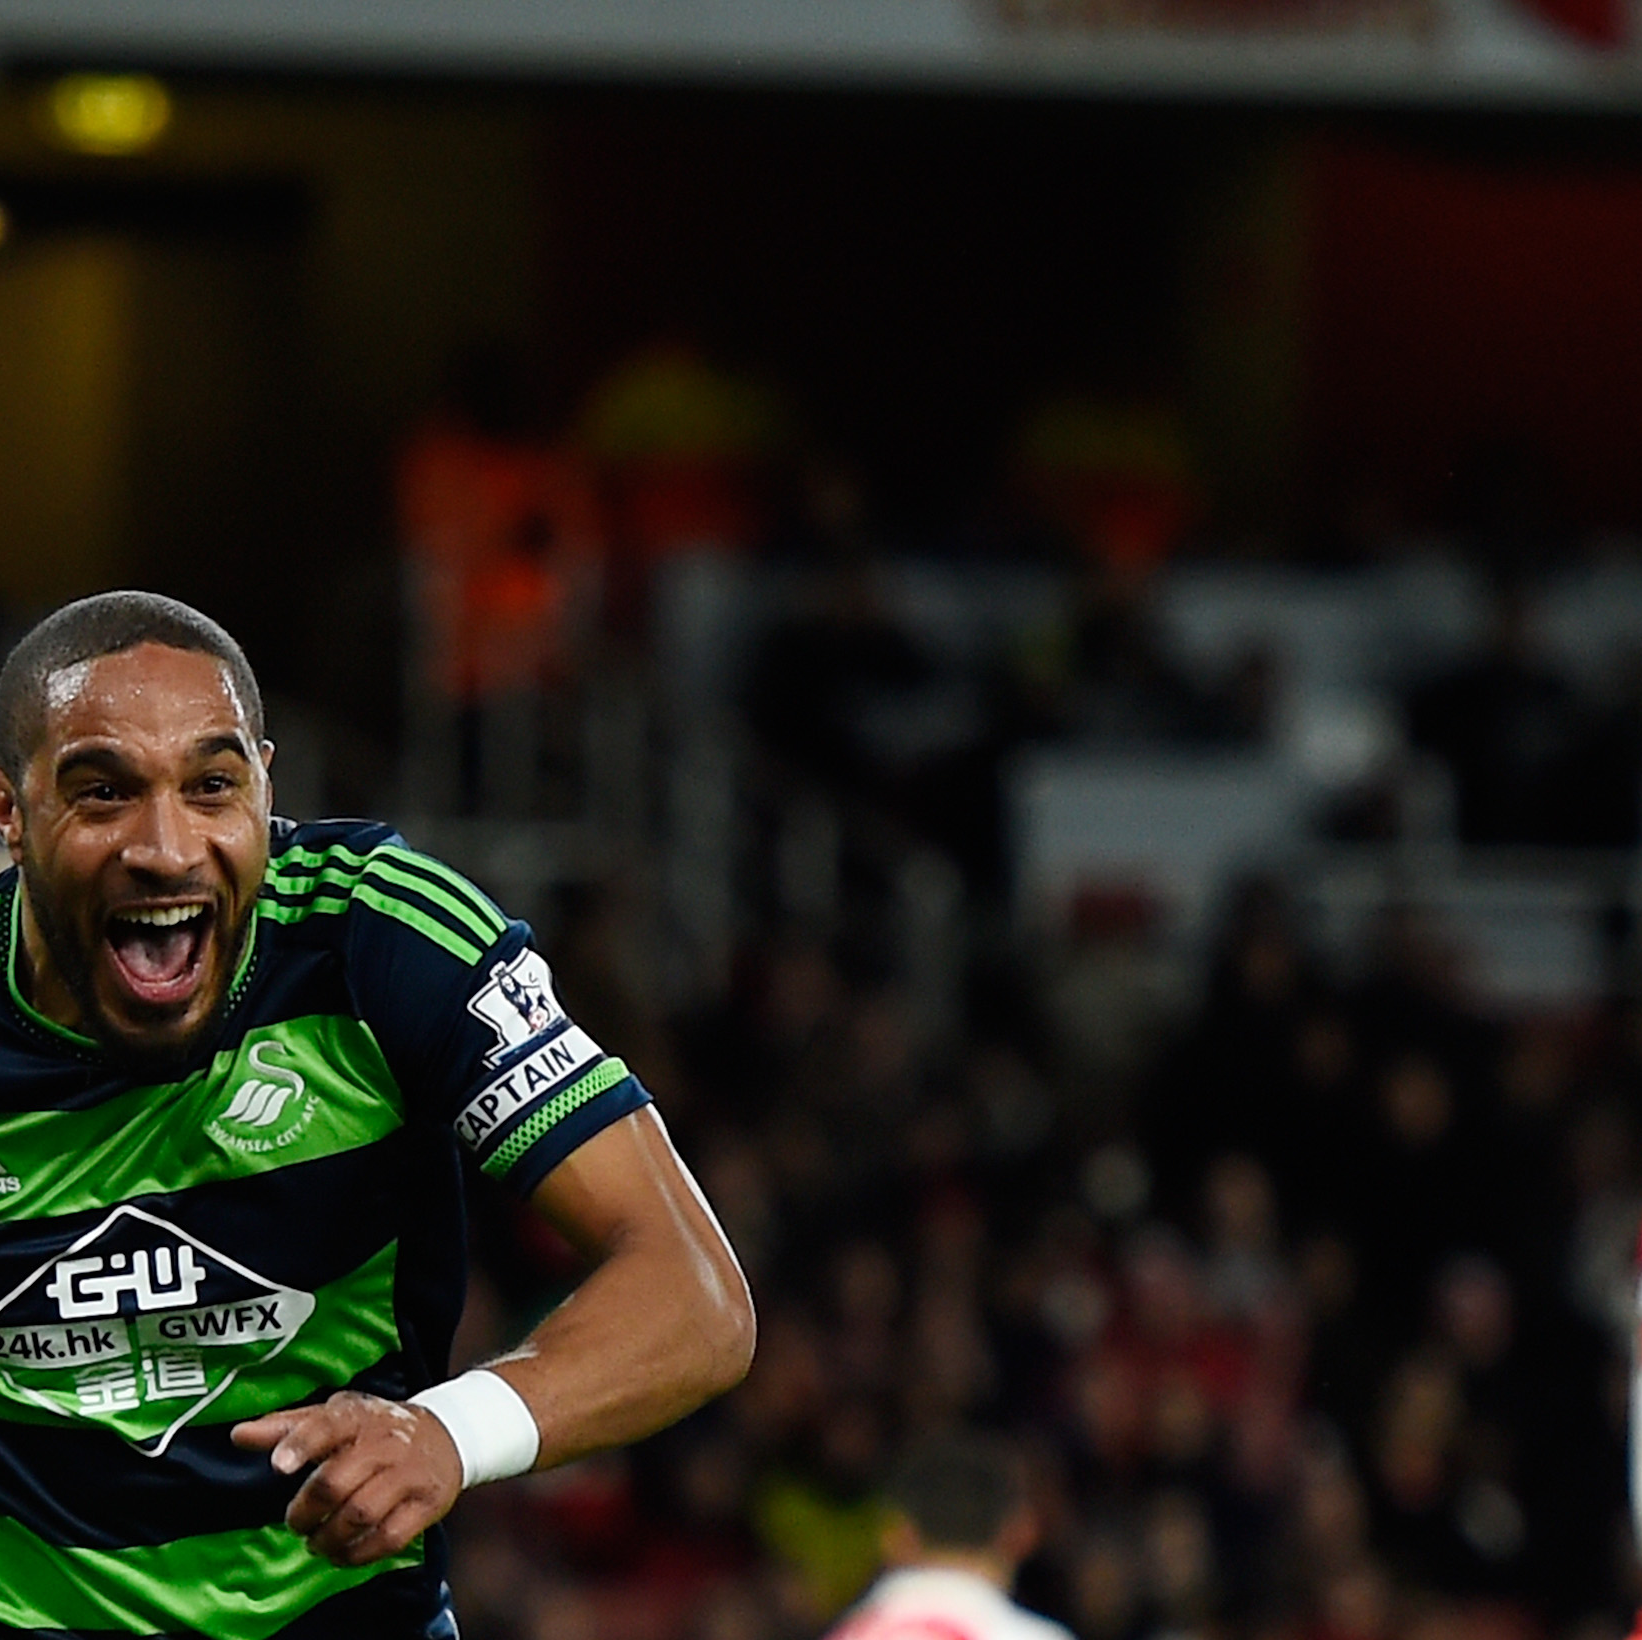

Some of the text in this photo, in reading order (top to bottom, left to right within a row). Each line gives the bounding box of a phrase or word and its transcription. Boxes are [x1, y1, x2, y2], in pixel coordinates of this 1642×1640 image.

[458, 1040, 576, 1146] CAPTAIN
[207, 1120, 274, 1152] SWANSEA
[277, 1122, 302, 1147] CITY
[159, 1301, 280, 1339] GWFX
